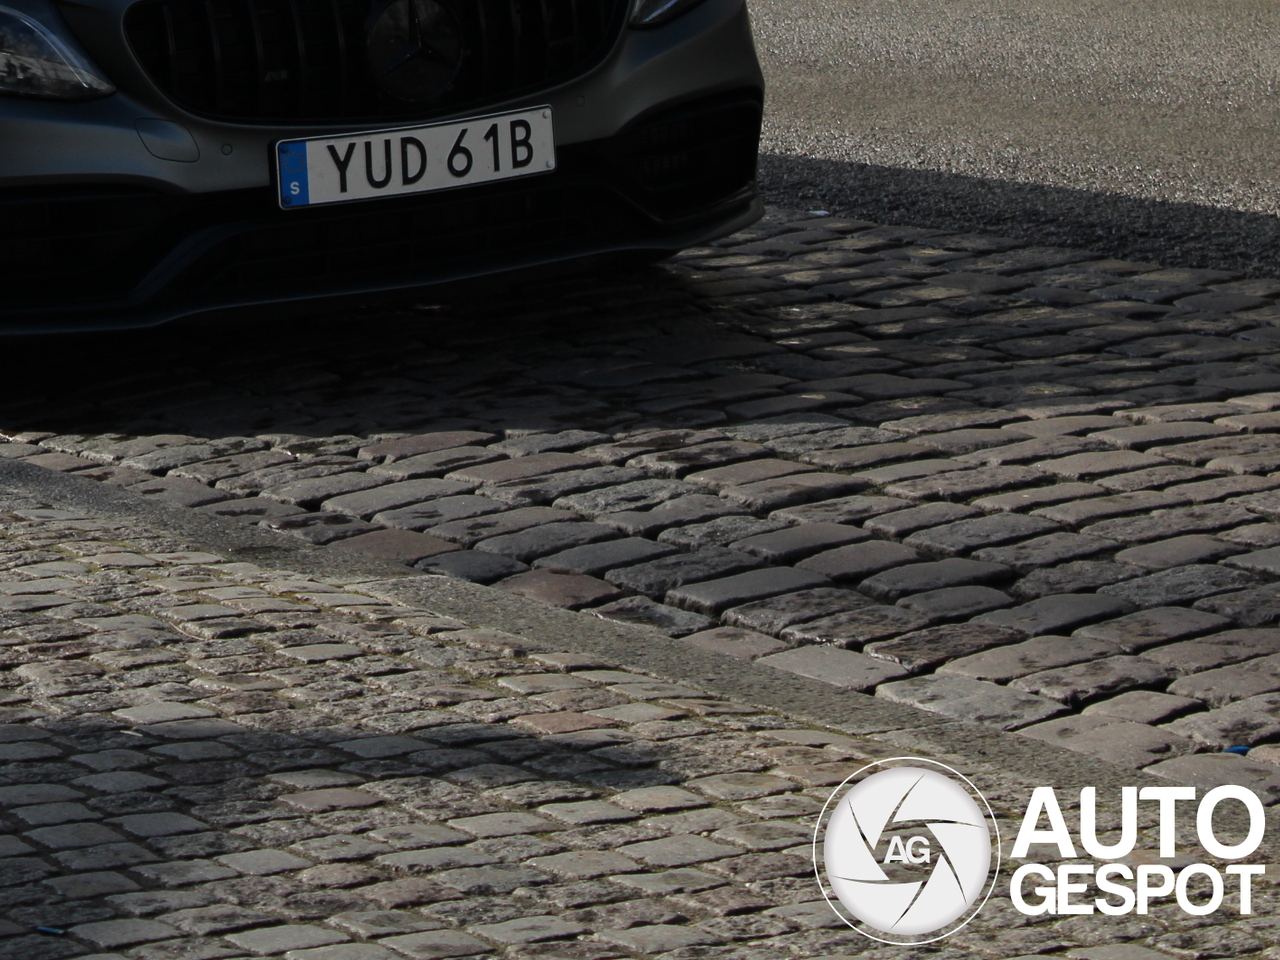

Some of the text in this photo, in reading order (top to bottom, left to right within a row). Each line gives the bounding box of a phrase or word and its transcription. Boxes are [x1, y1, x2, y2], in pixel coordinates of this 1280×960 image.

[326, 118, 534, 194] YUD 61B
[290, 181, 300, 195] S
